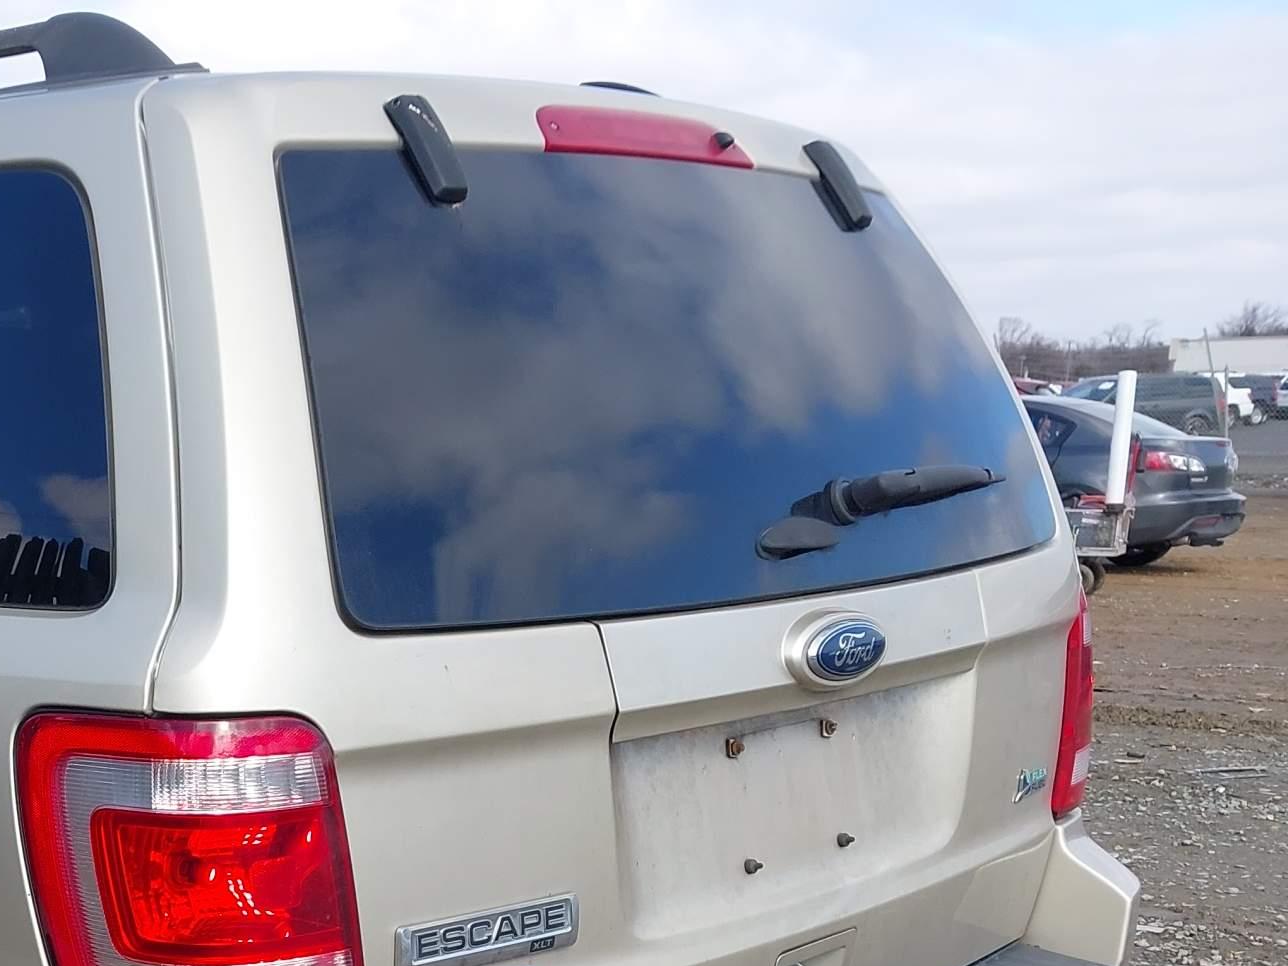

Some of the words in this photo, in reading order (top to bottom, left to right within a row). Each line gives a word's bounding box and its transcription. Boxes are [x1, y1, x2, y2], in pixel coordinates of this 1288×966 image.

[832, 632, 876, 667] Ford
[415, 902, 566, 959] ESCAPE
[531, 937, 554, 951] XLT
